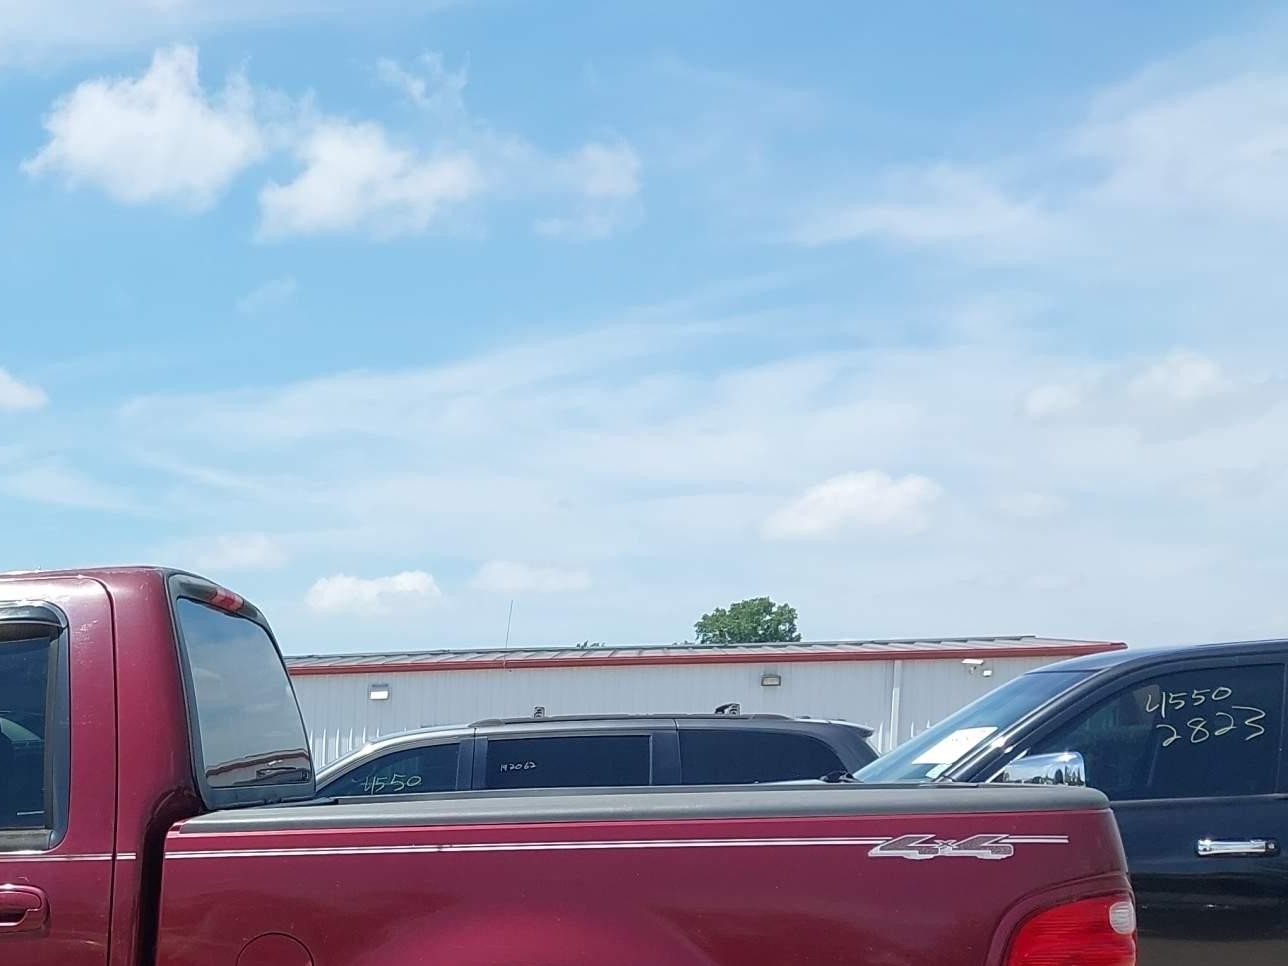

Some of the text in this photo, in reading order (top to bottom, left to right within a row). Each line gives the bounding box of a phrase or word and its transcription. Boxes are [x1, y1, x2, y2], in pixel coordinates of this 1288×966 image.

[1146, 686, 1232, 718] 4550
[1156, 705, 1266, 746] 2823
[361, 774, 422, 795] 4550
